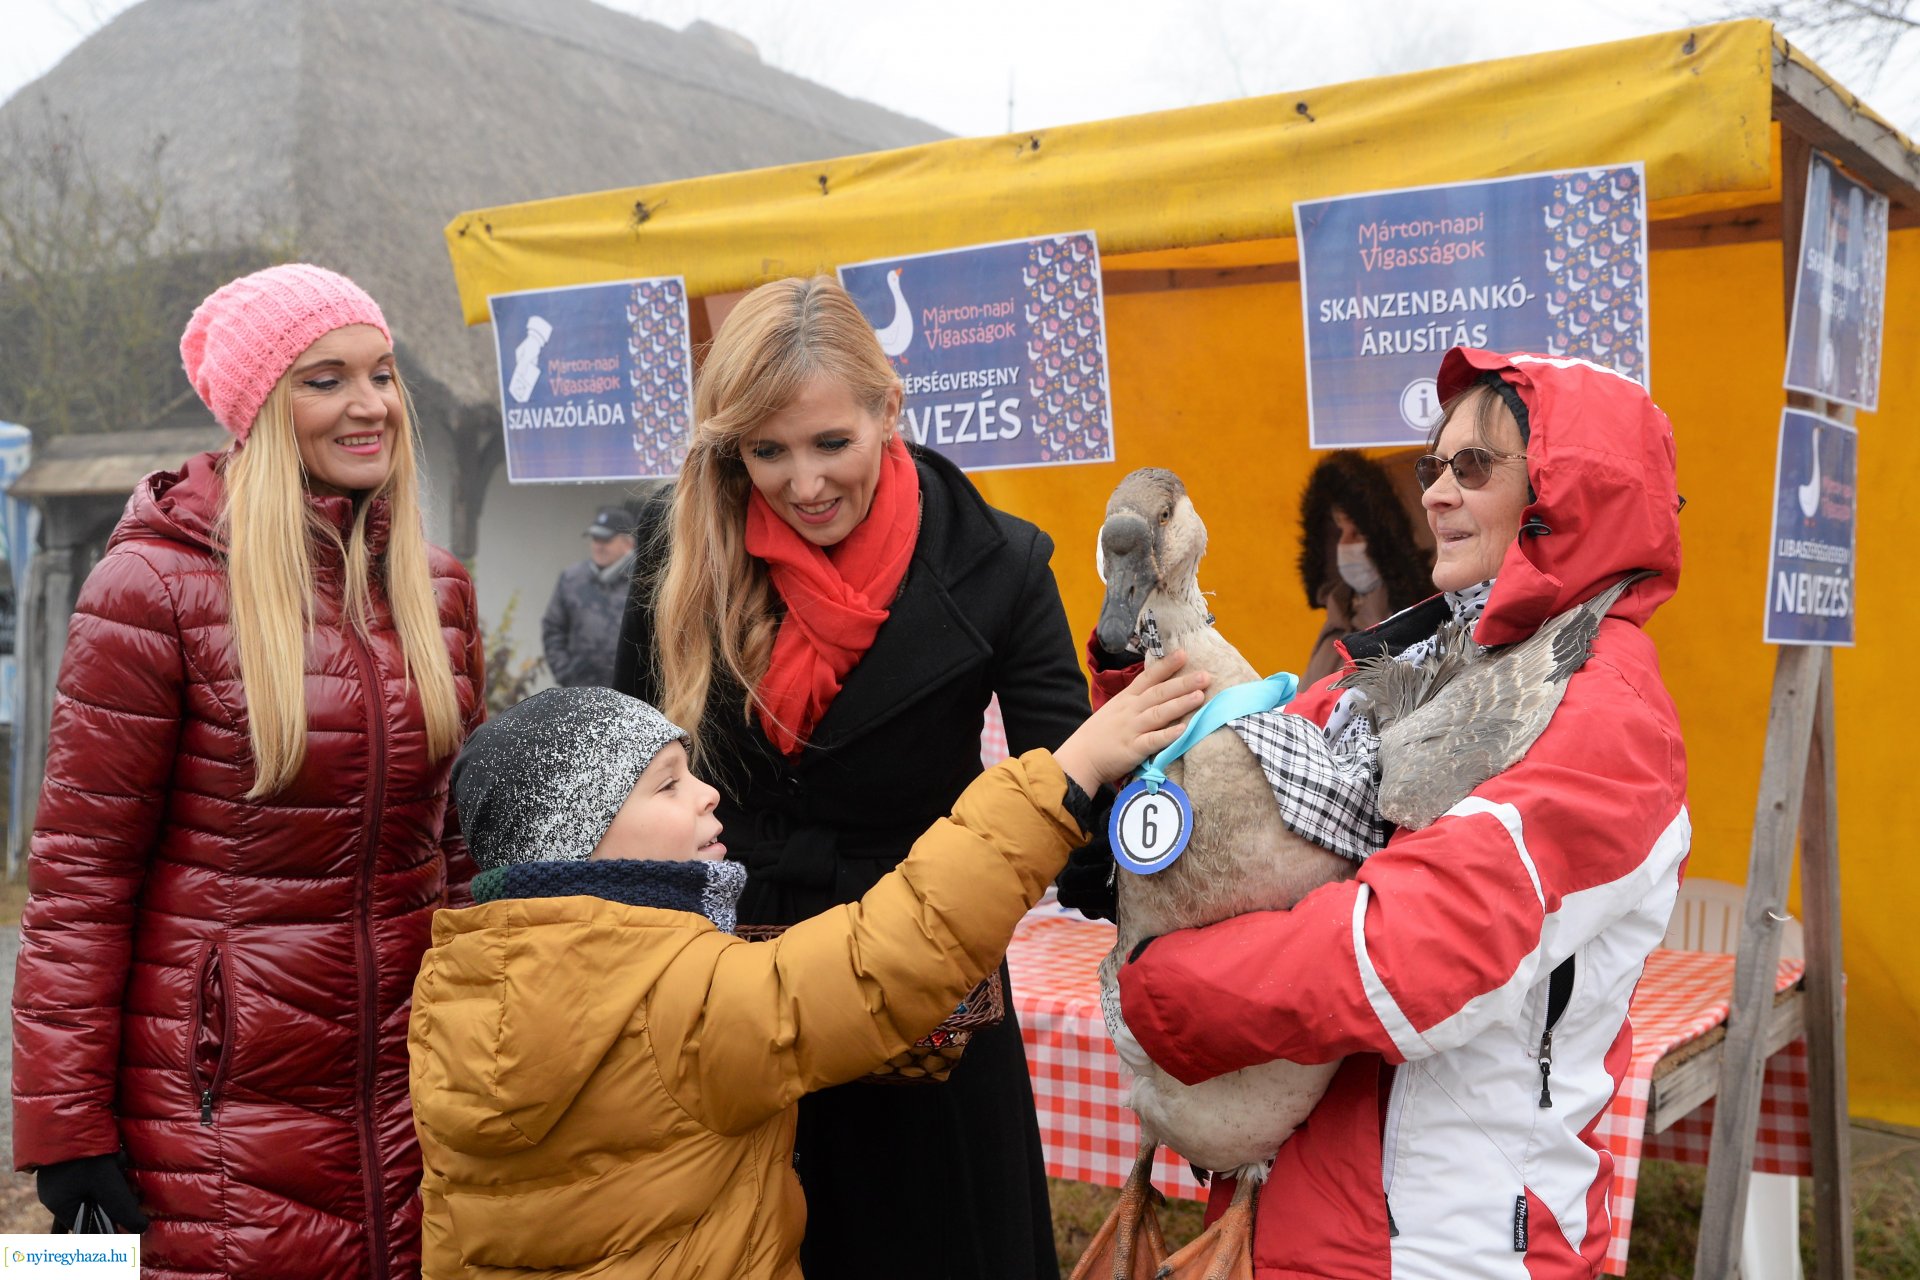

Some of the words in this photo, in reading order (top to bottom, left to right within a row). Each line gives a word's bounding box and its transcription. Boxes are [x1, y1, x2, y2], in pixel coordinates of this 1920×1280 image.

[1359, 212, 1485, 247] Márton-napi
[1359, 240, 1485, 272] Vigasságok
[923, 298, 1015, 327] Márton-napi
[1319, 277, 1536, 323] SKANZENBANKÓ-
[924, 322, 1016, 351] Vigasságok
[1360, 320, 1488, 356] ÁRUSÍTÁS
[548, 354, 620, 376] Márton-napi
[549, 373, 621, 397] Vigasságok
[508, 399, 626, 430] SZAVAZÓLÁDA
[1775, 568, 1850, 618] NEVEZÉS
[1142, 803, 1158, 849] 6
